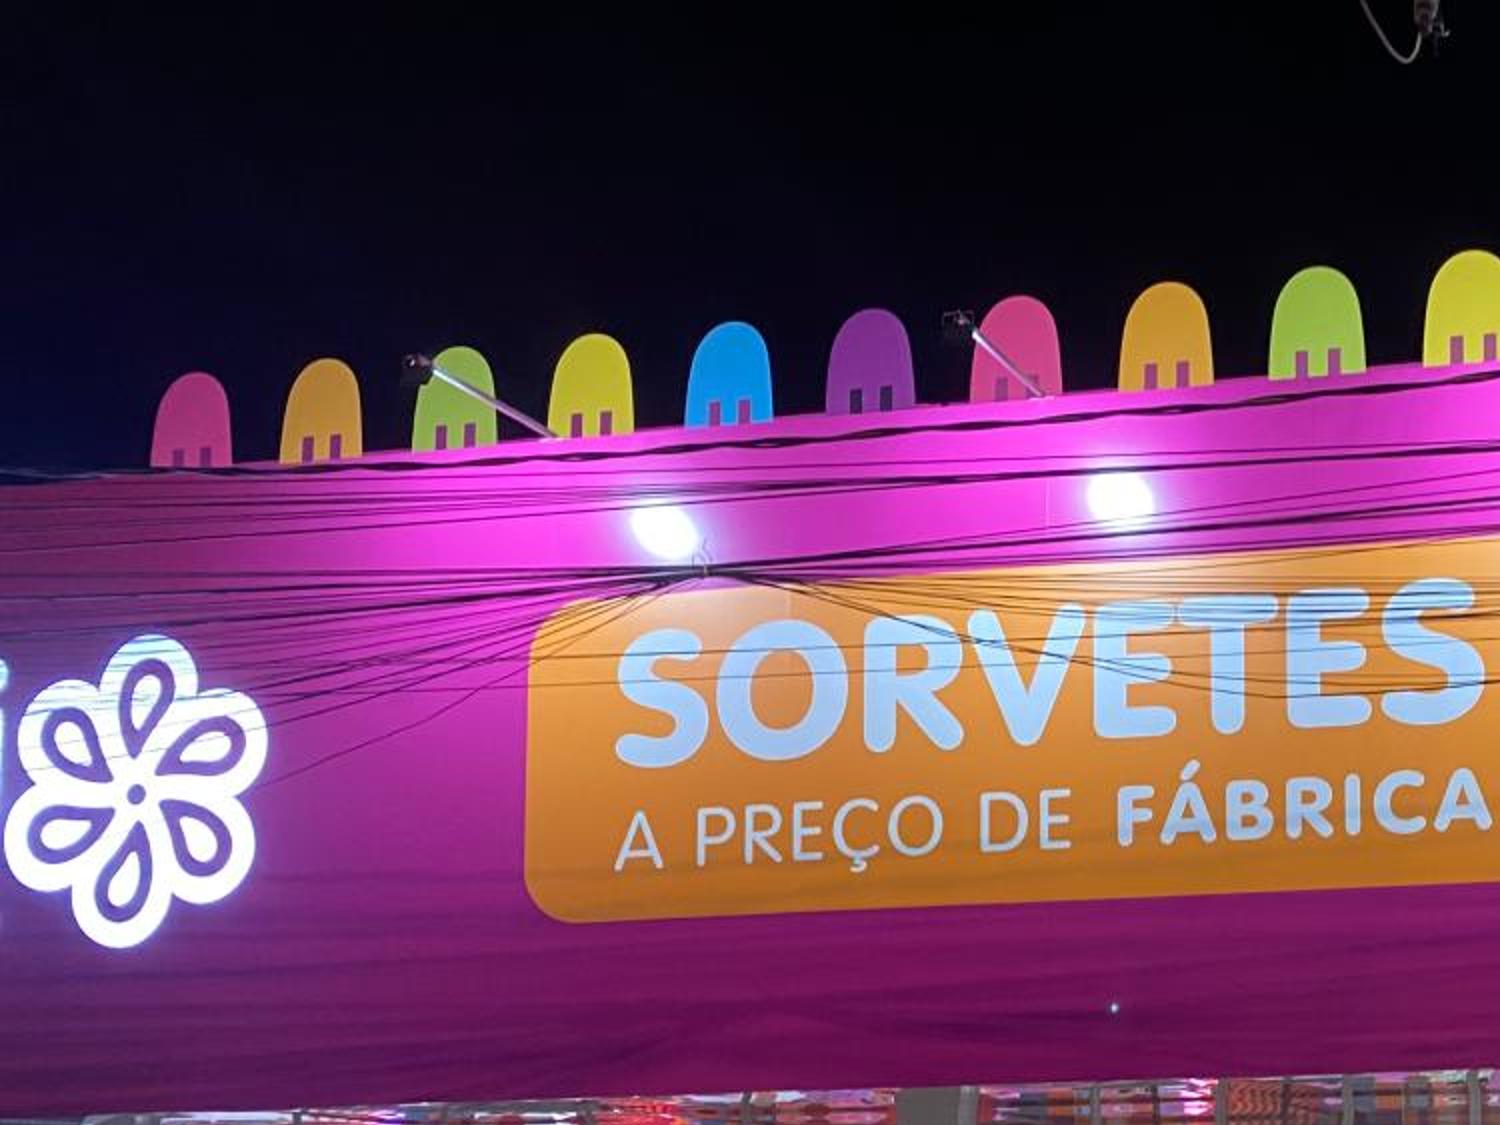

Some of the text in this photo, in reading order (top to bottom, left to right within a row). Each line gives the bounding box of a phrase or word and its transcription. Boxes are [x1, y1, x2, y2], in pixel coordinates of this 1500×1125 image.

[614, 578, 1486, 768] SORVETES
[614, 759, 1493, 873] A PREÇO DE FÁBRICA
